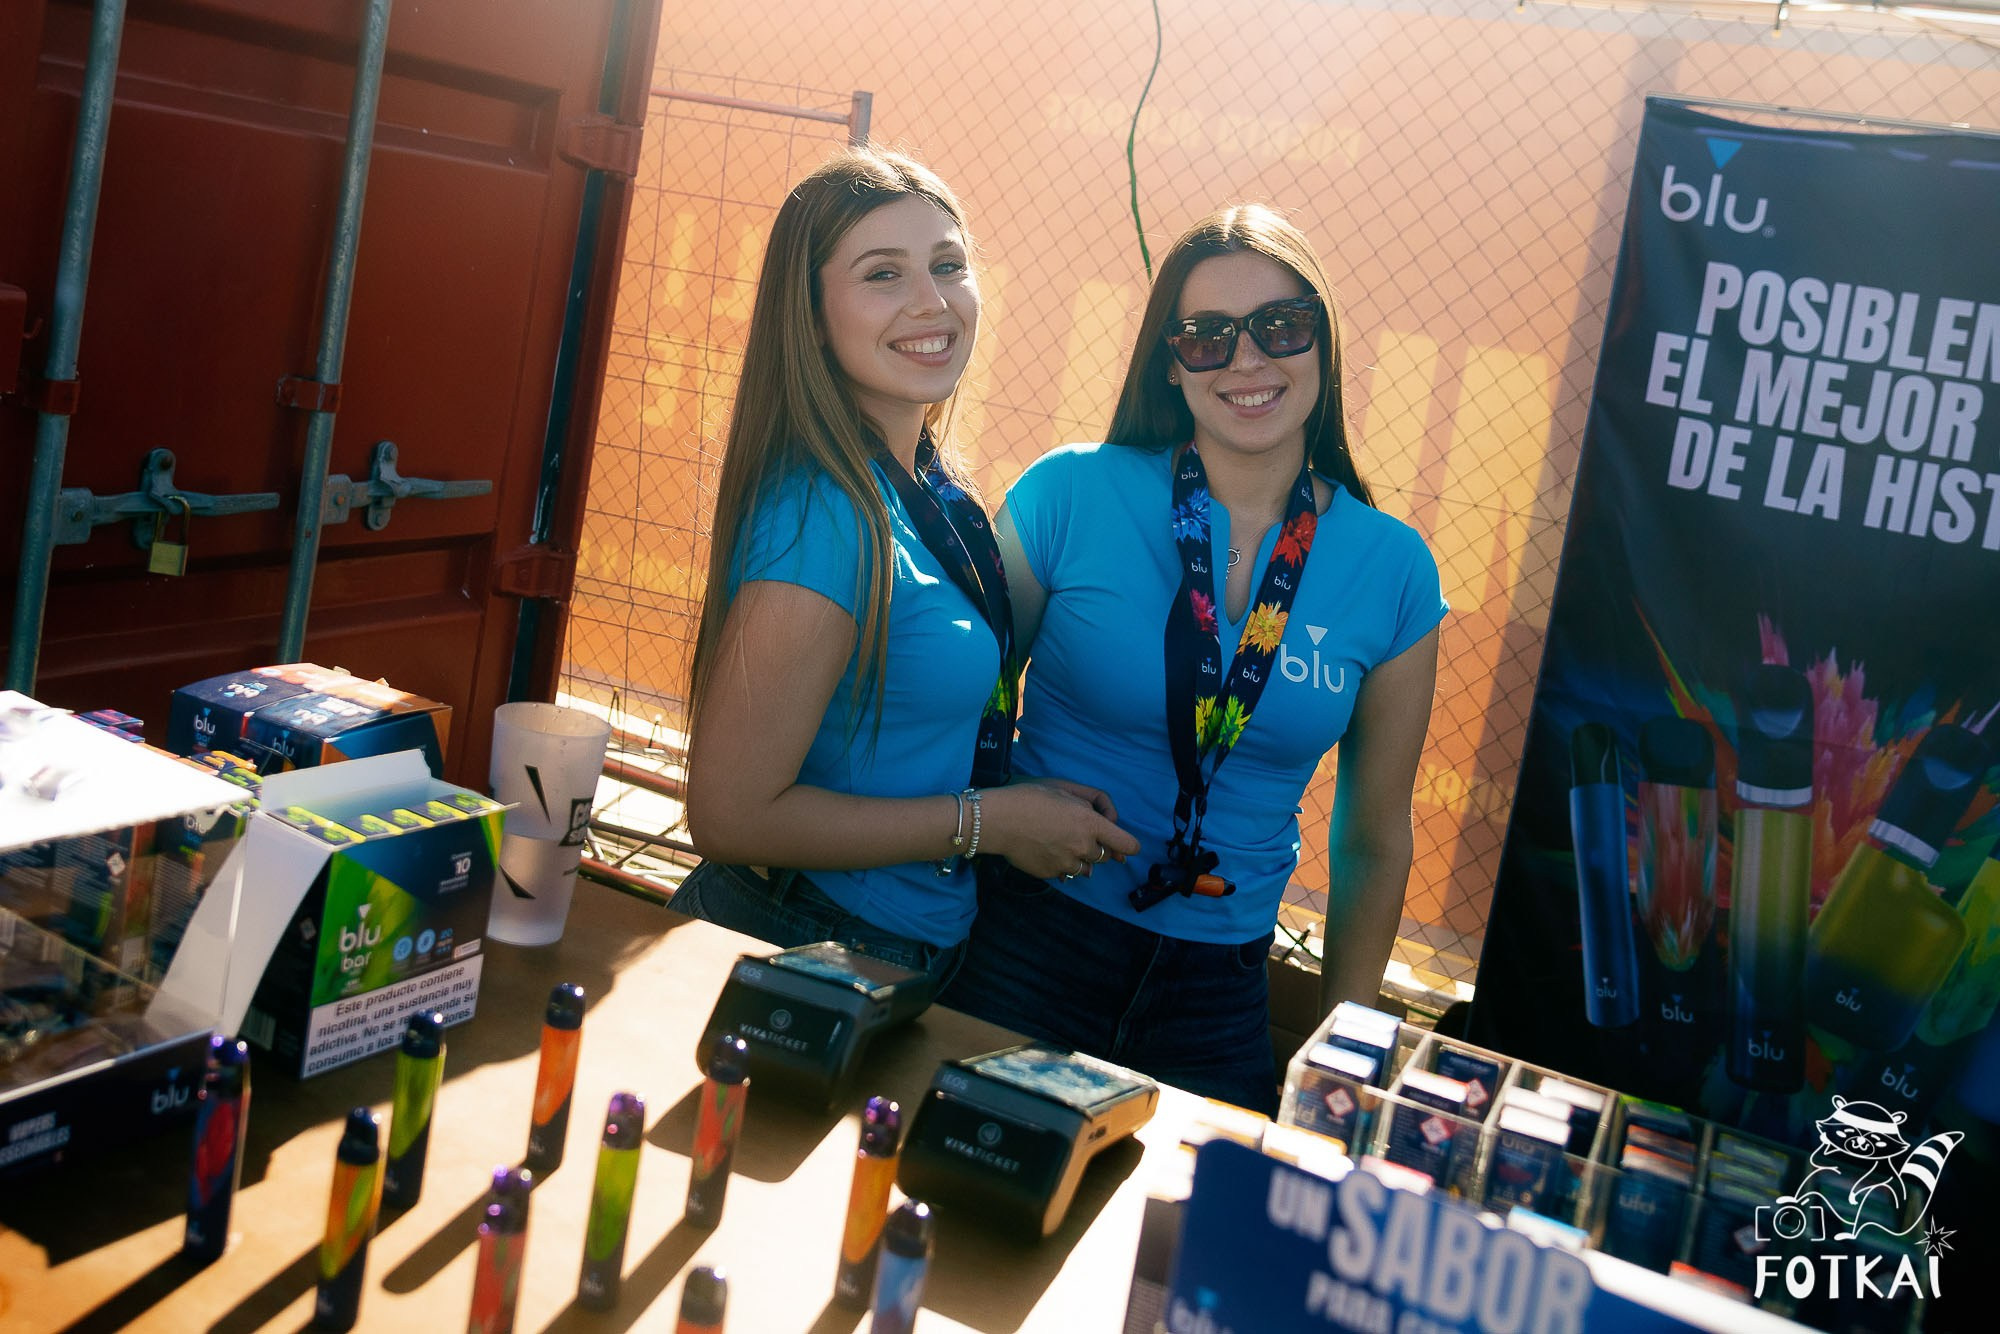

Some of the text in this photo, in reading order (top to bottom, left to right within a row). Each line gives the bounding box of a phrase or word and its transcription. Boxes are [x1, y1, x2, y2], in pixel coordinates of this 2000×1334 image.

[1660, 164, 1769, 234] blu
[1644, 331, 1984, 463] EL MEJOR
[1180, 470, 1199, 481] blu
[1666, 416, 2000, 551] DE LA HIST
[1190, 562, 1208, 574] blu
[1273, 575, 1292, 591] blu
[1201, 662, 1217, 675] blu
[1242, 667, 1261, 684] blu
[1280, 643, 1345, 694] blu
[192, 715, 217, 735] blu
[271, 736, 295, 758] blu
[979, 737, 998, 750] blu
[455, 857, 472, 875] 10
[338, 921, 382, 953] blu
[341, 950, 373, 973] bar
[336, 1002, 363, 1017] Este
[366, 983, 417, 1010] producto
[420, 967, 465, 990] contiene
[373, 1006, 395, 1020] una
[397, 986, 450, 1011] sustancia
[452, 978, 474, 993] muy
[1834, 990, 1862, 1013] blu
[309, 1032, 360, 1056] adictiva.
[363, 1024, 380, 1038] No
[382, 1020, 396, 1032] se
[463, 991, 477, 1003] su
[1660, 1003, 1695, 1024] blu
[738, 1022, 809, 1052] VIVATICKET
[1747, 1037, 1785, 1061] blu
[307, 1046, 364, 1072] consumo
[366, 1041, 375, 1052] a
[377, 1034, 395, 1048] los
[1880, 1066, 1919, 1099] blu
[151, 1084, 191, 1115] blu
[943, 1135, 1021, 1173] VIVATICKET
[1266, 1166, 1592, 1334] UN SABOR
